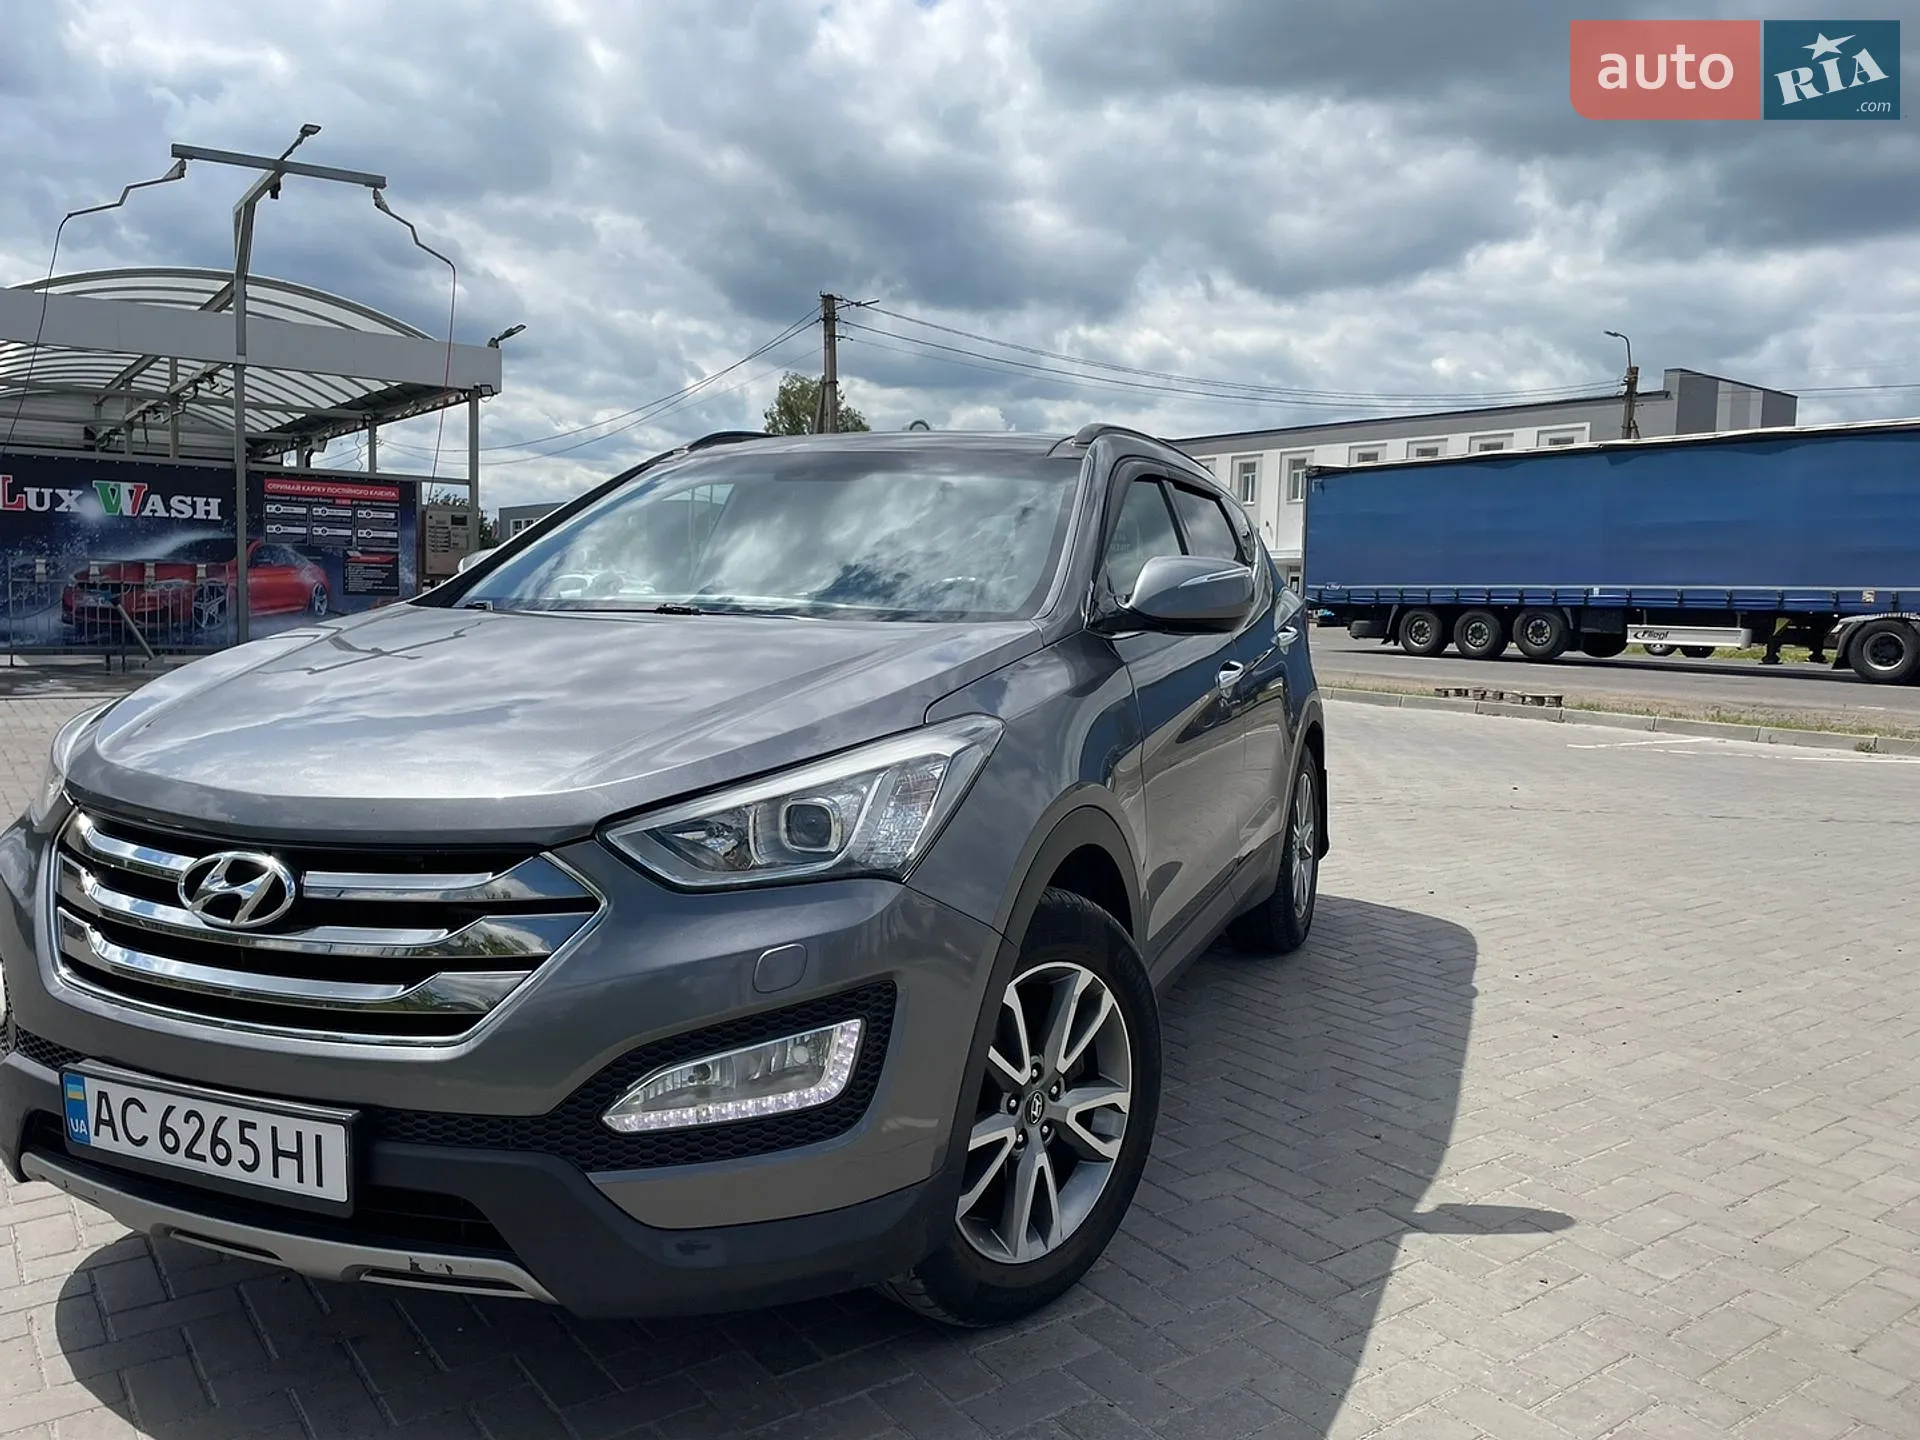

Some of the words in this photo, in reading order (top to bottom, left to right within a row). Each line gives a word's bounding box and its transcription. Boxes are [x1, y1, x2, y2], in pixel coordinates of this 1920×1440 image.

[0, 474, 84, 513] LUX
[92, 480, 222, 520] WASH
[68, 1117, 89, 1136] UA
